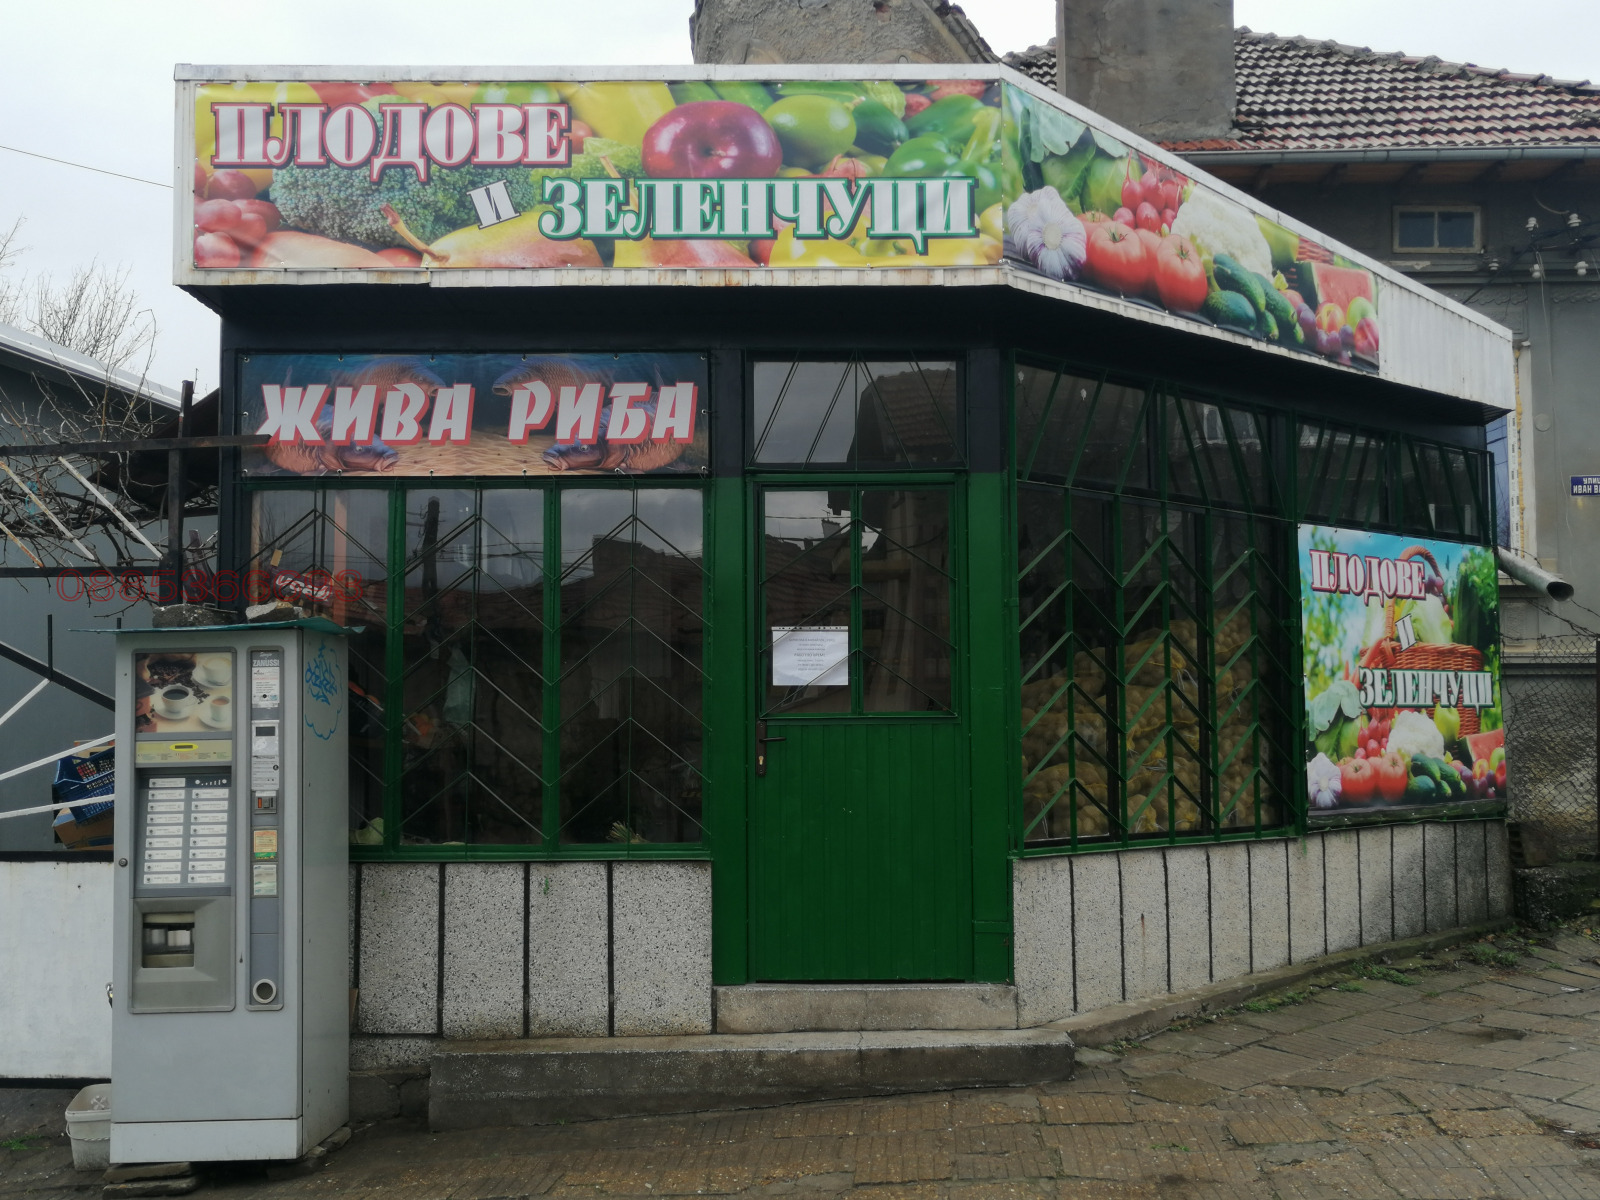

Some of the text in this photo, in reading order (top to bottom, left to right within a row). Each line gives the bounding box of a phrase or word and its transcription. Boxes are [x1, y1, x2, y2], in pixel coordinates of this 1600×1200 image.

[211, 102, 572, 184] ПЛОДОВЕ
[467, 179, 521, 230] И
[538, 175, 979, 255] ЗЕЛЕНЧУЦИ
[254, 380, 698, 446] ЖИВА РИБА
[1573, 485, 1592, 493] ИВАН
[1309, 549, 1426, 608] ПЛОДОВЕ
[1395, 613, 1418, 651] И
[252, 659, 280, 667] ZANUSSI
[1359, 666, 1495, 717] ЗЕЛЕНЧУЦИ
